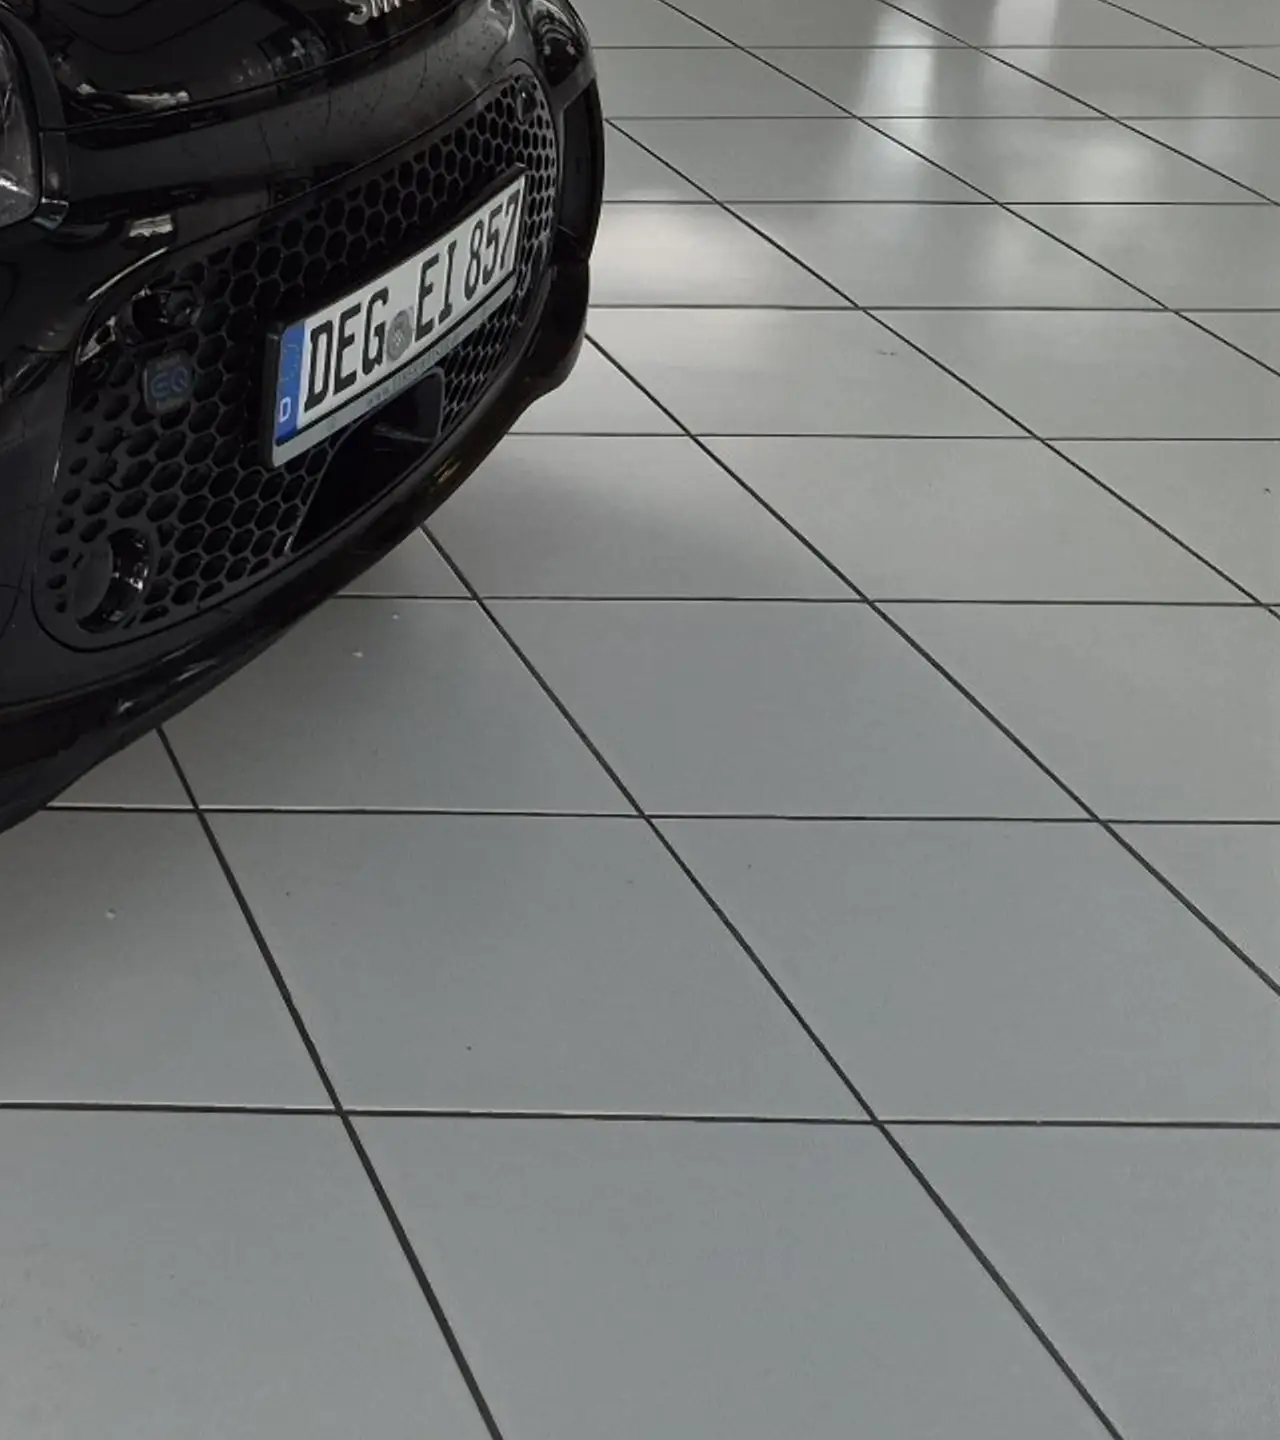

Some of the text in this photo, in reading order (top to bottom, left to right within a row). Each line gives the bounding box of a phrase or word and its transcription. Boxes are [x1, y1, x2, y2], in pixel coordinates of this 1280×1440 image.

[303, 286, 390, 413] DEG
[413, 239, 458, 343] EI
[463, 188, 522, 302] 857
